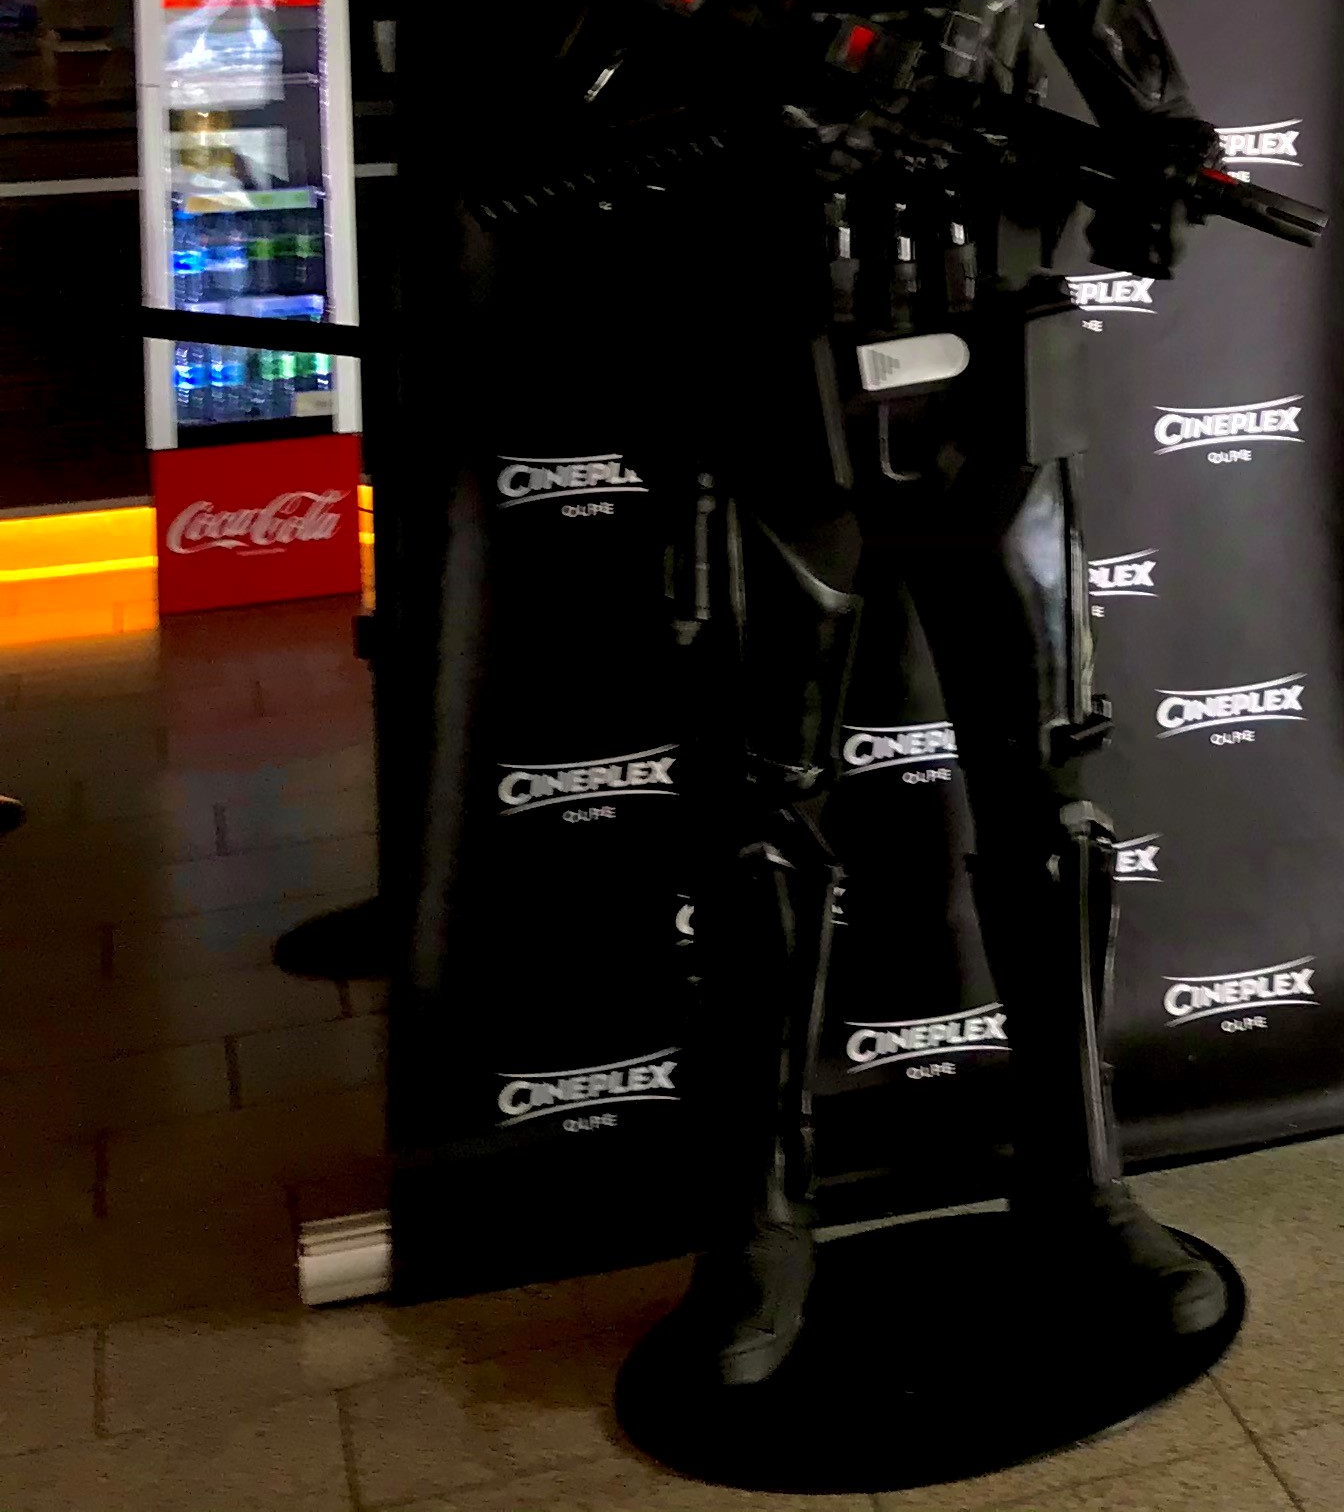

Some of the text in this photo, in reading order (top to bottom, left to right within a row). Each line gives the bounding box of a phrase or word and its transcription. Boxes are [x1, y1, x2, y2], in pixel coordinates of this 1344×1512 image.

[1219, 131, 1300, 157] PLEX
[1068, 277, 1155, 305] PLEX
[1154, 407, 1302, 445] CINEPLEX
[1157, 685, 1305, 730] CINEPLEX
[843, 729, 957, 767] CINEPL
[497, 757, 677, 806] CINEPLEX
[1164, 968, 1315, 1017] CINEPLEX
[846, 1012, 1009, 1064] CINEPLEX
[498, 1061, 678, 1116] CINEPLEX
